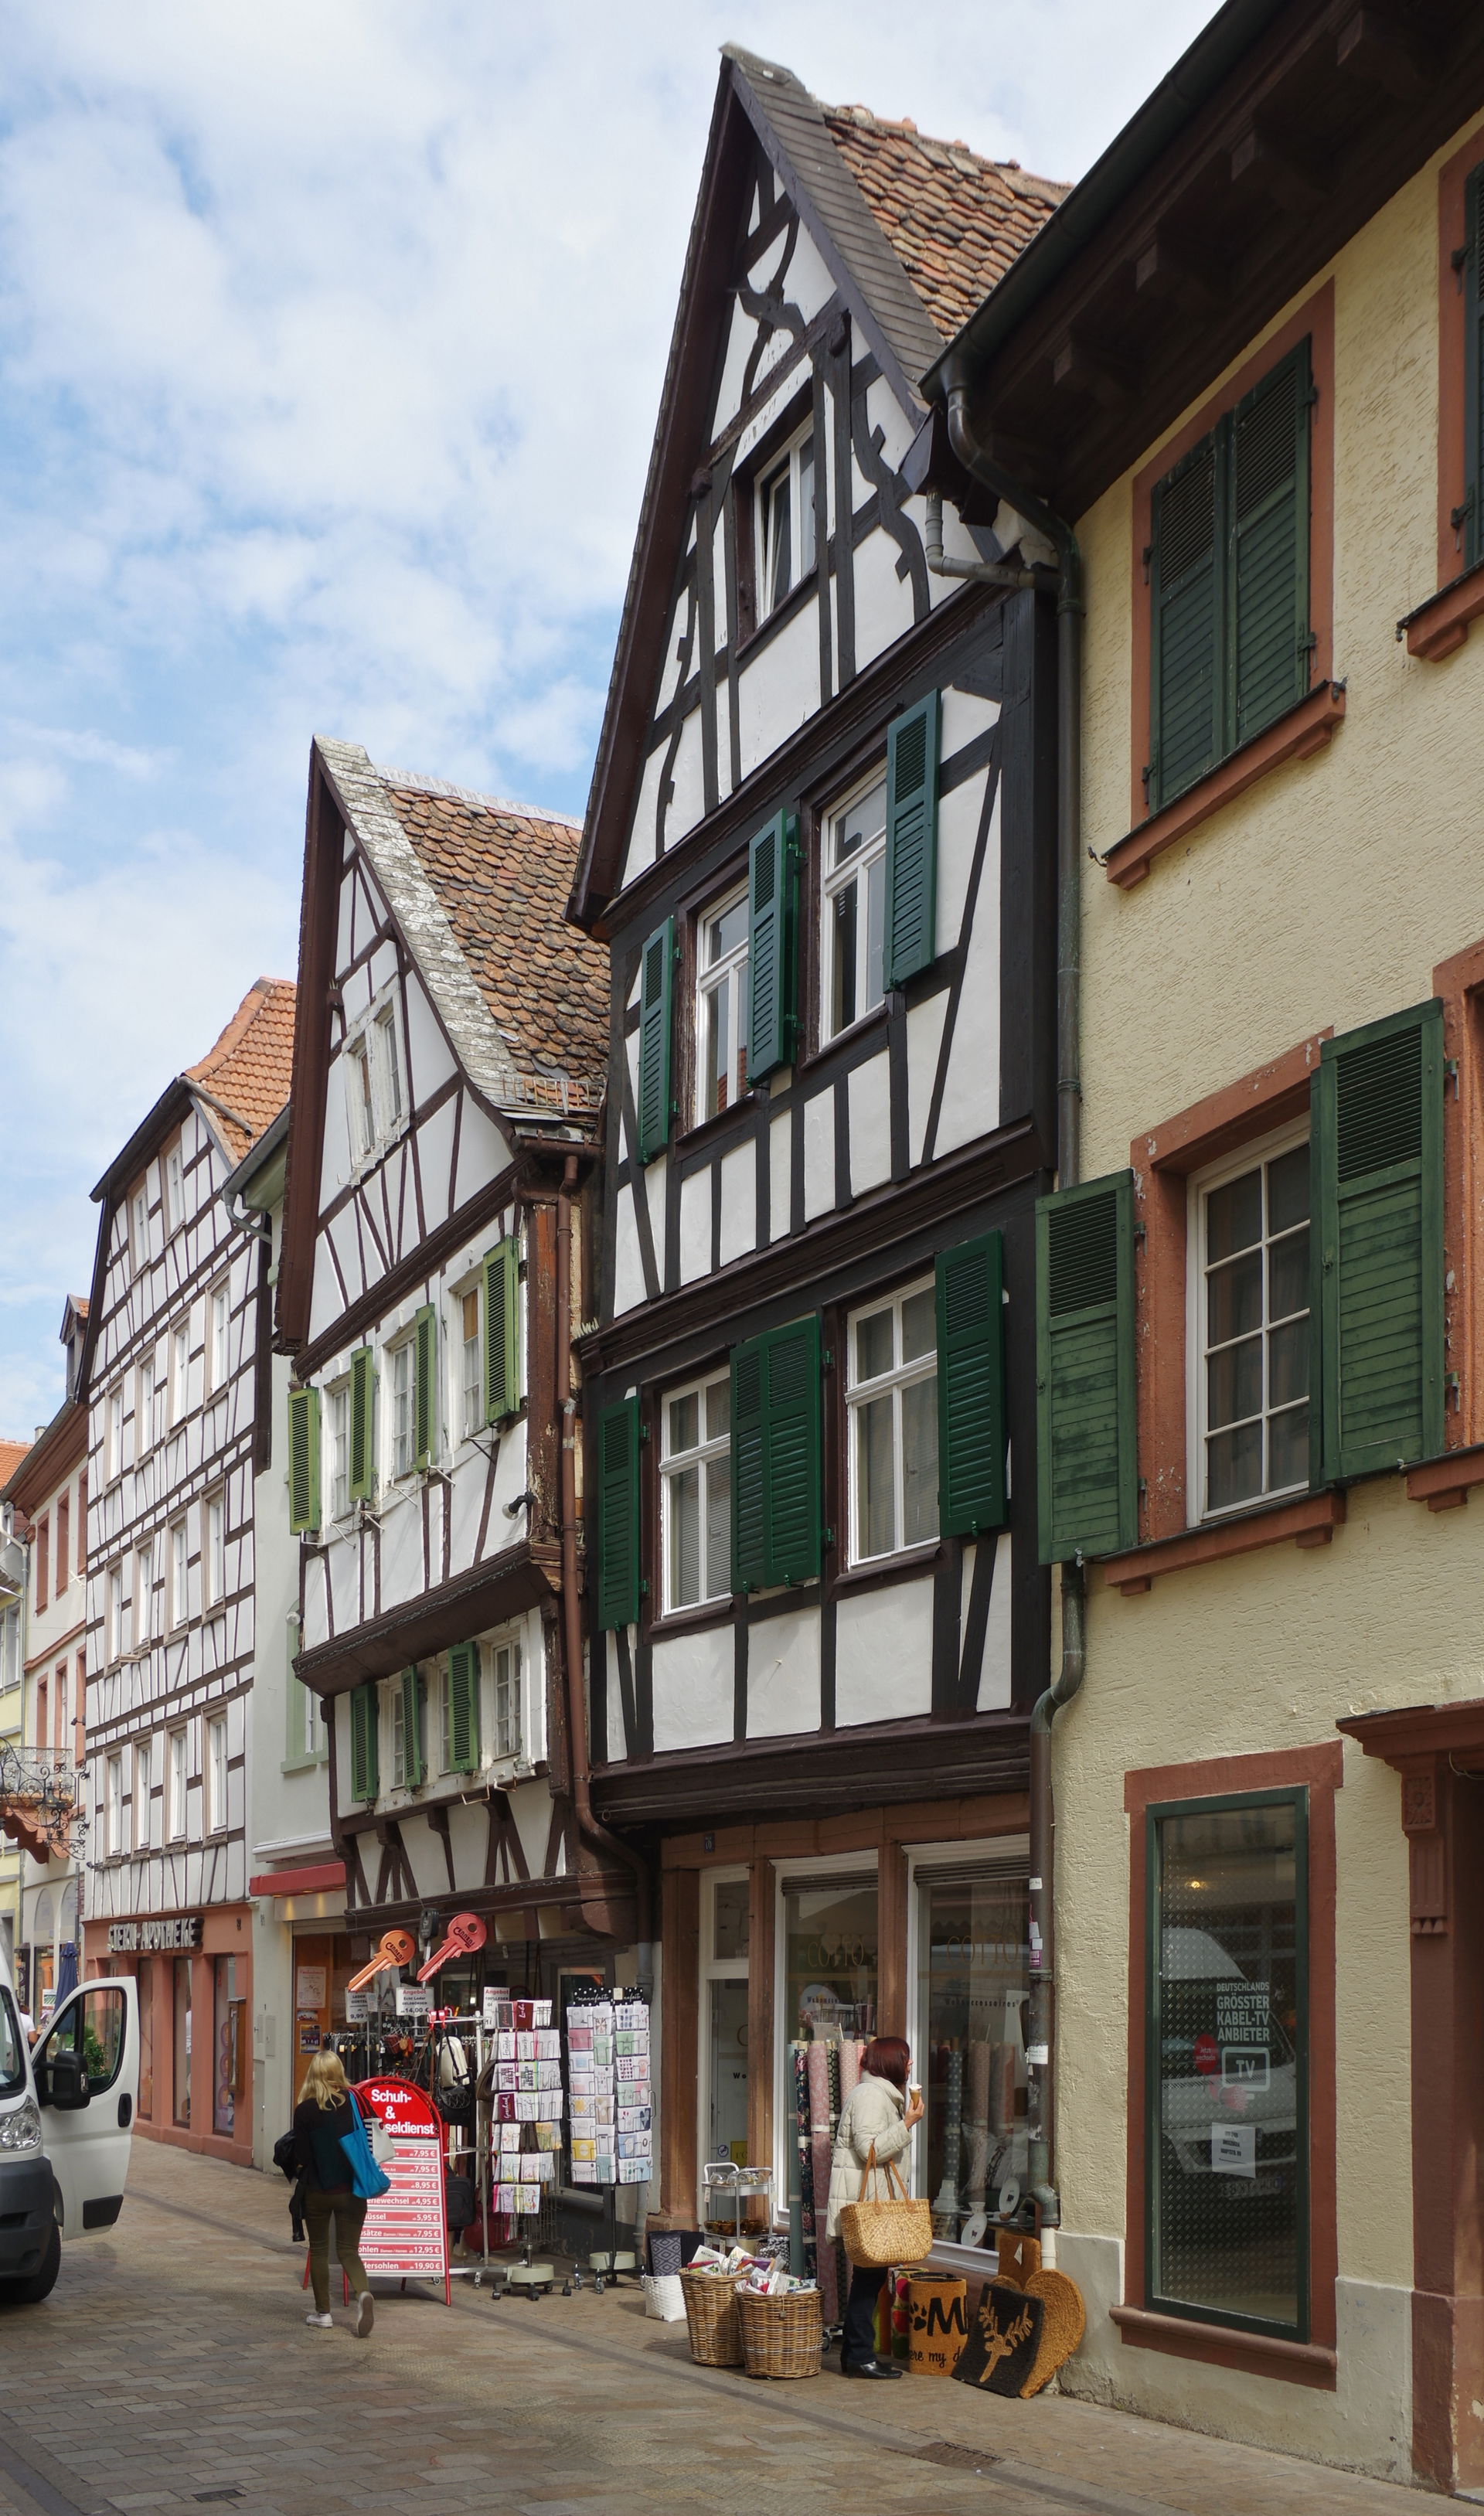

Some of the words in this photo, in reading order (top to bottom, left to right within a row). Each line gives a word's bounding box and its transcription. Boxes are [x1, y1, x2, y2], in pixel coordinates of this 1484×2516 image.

[107, 1917, 198, 1953] STERN-APOTHEKE
[808, 1940, 864, 1967] COTTO
[947, 1934, 1018, 1964] COTTO
[1217, 1982, 1270, 1992] DEUTSCHLANDS
[1217, 1993, 1270, 2010] GRÖSSTER
[1217, 2010, 1270, 2026] KABEL-TV
[1217, 2027, 1270, 2041] ANBIETER
[1236, 2060, 1255, 2079] TV
[372, 2089, 412, 2102] Schuh-
[385, 2106, 396, 2119] &
[385, 2121, 434, 2135] seldienst
[928, 2351, 947, 2368] my
